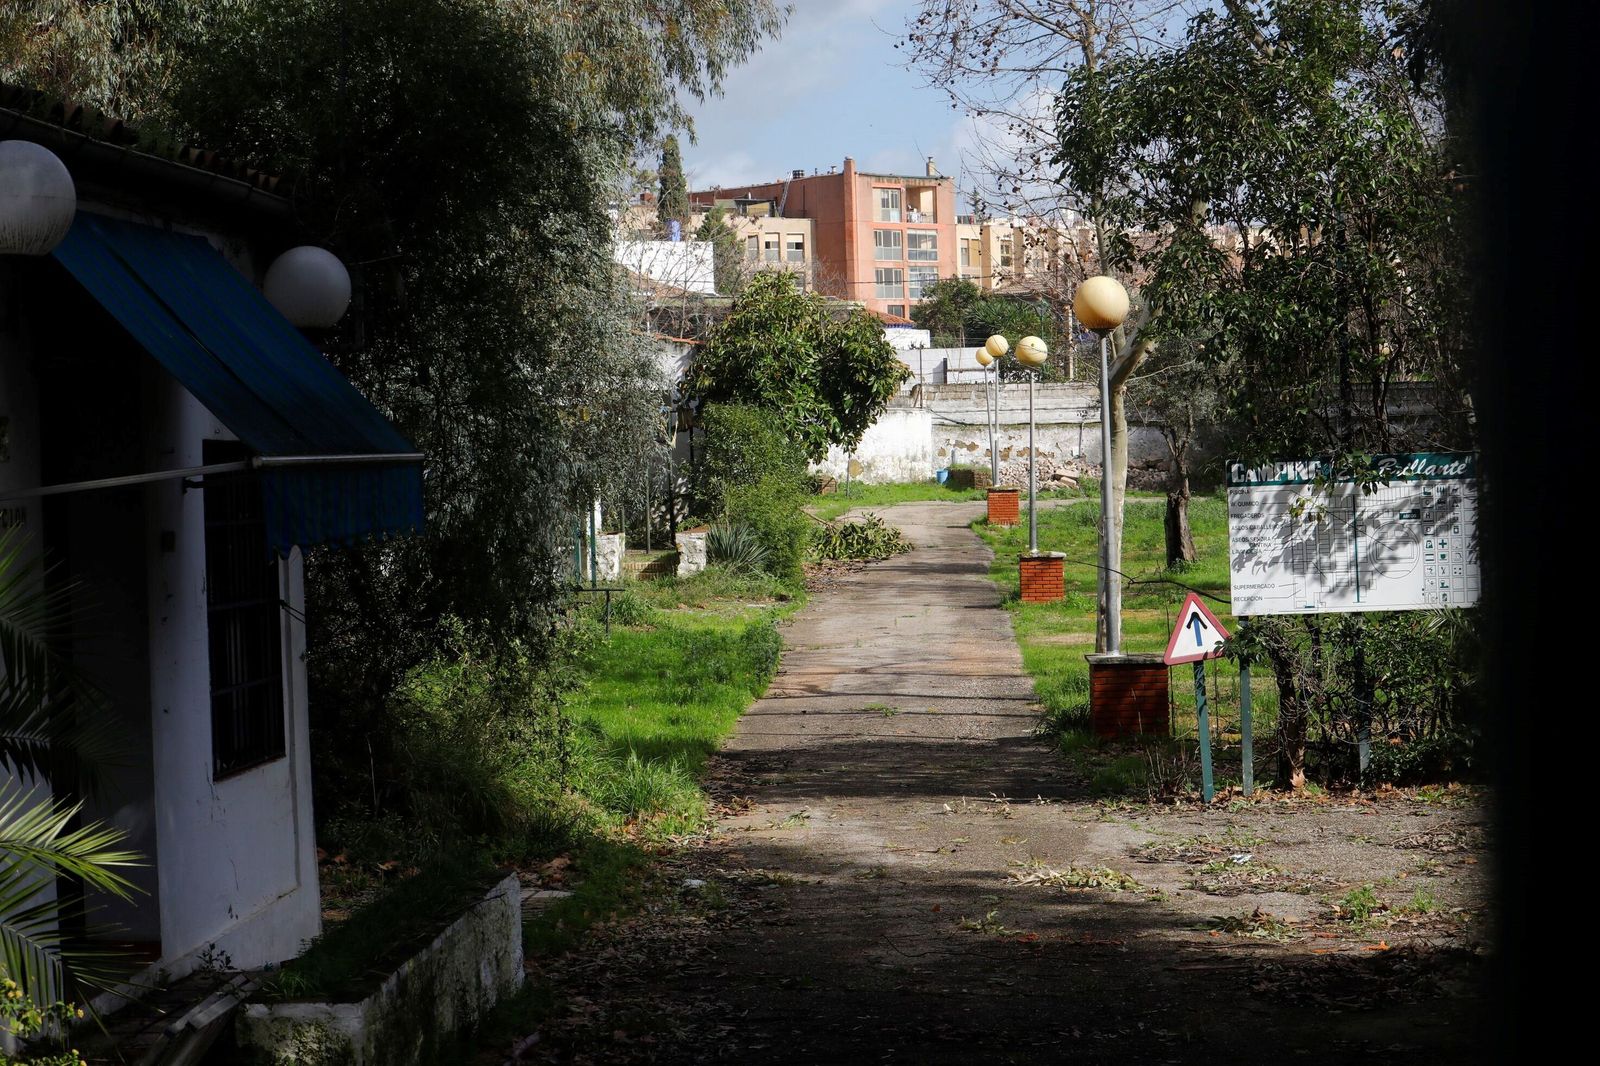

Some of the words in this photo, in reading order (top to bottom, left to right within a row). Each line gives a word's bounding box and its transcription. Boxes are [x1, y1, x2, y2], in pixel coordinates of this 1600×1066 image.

[1231, 460, 1323, 483] CAMPING
[1230, 512, 1265, 520] FREGADEROS
[1232, 583, 1276, 591] SUPERMERCADO
